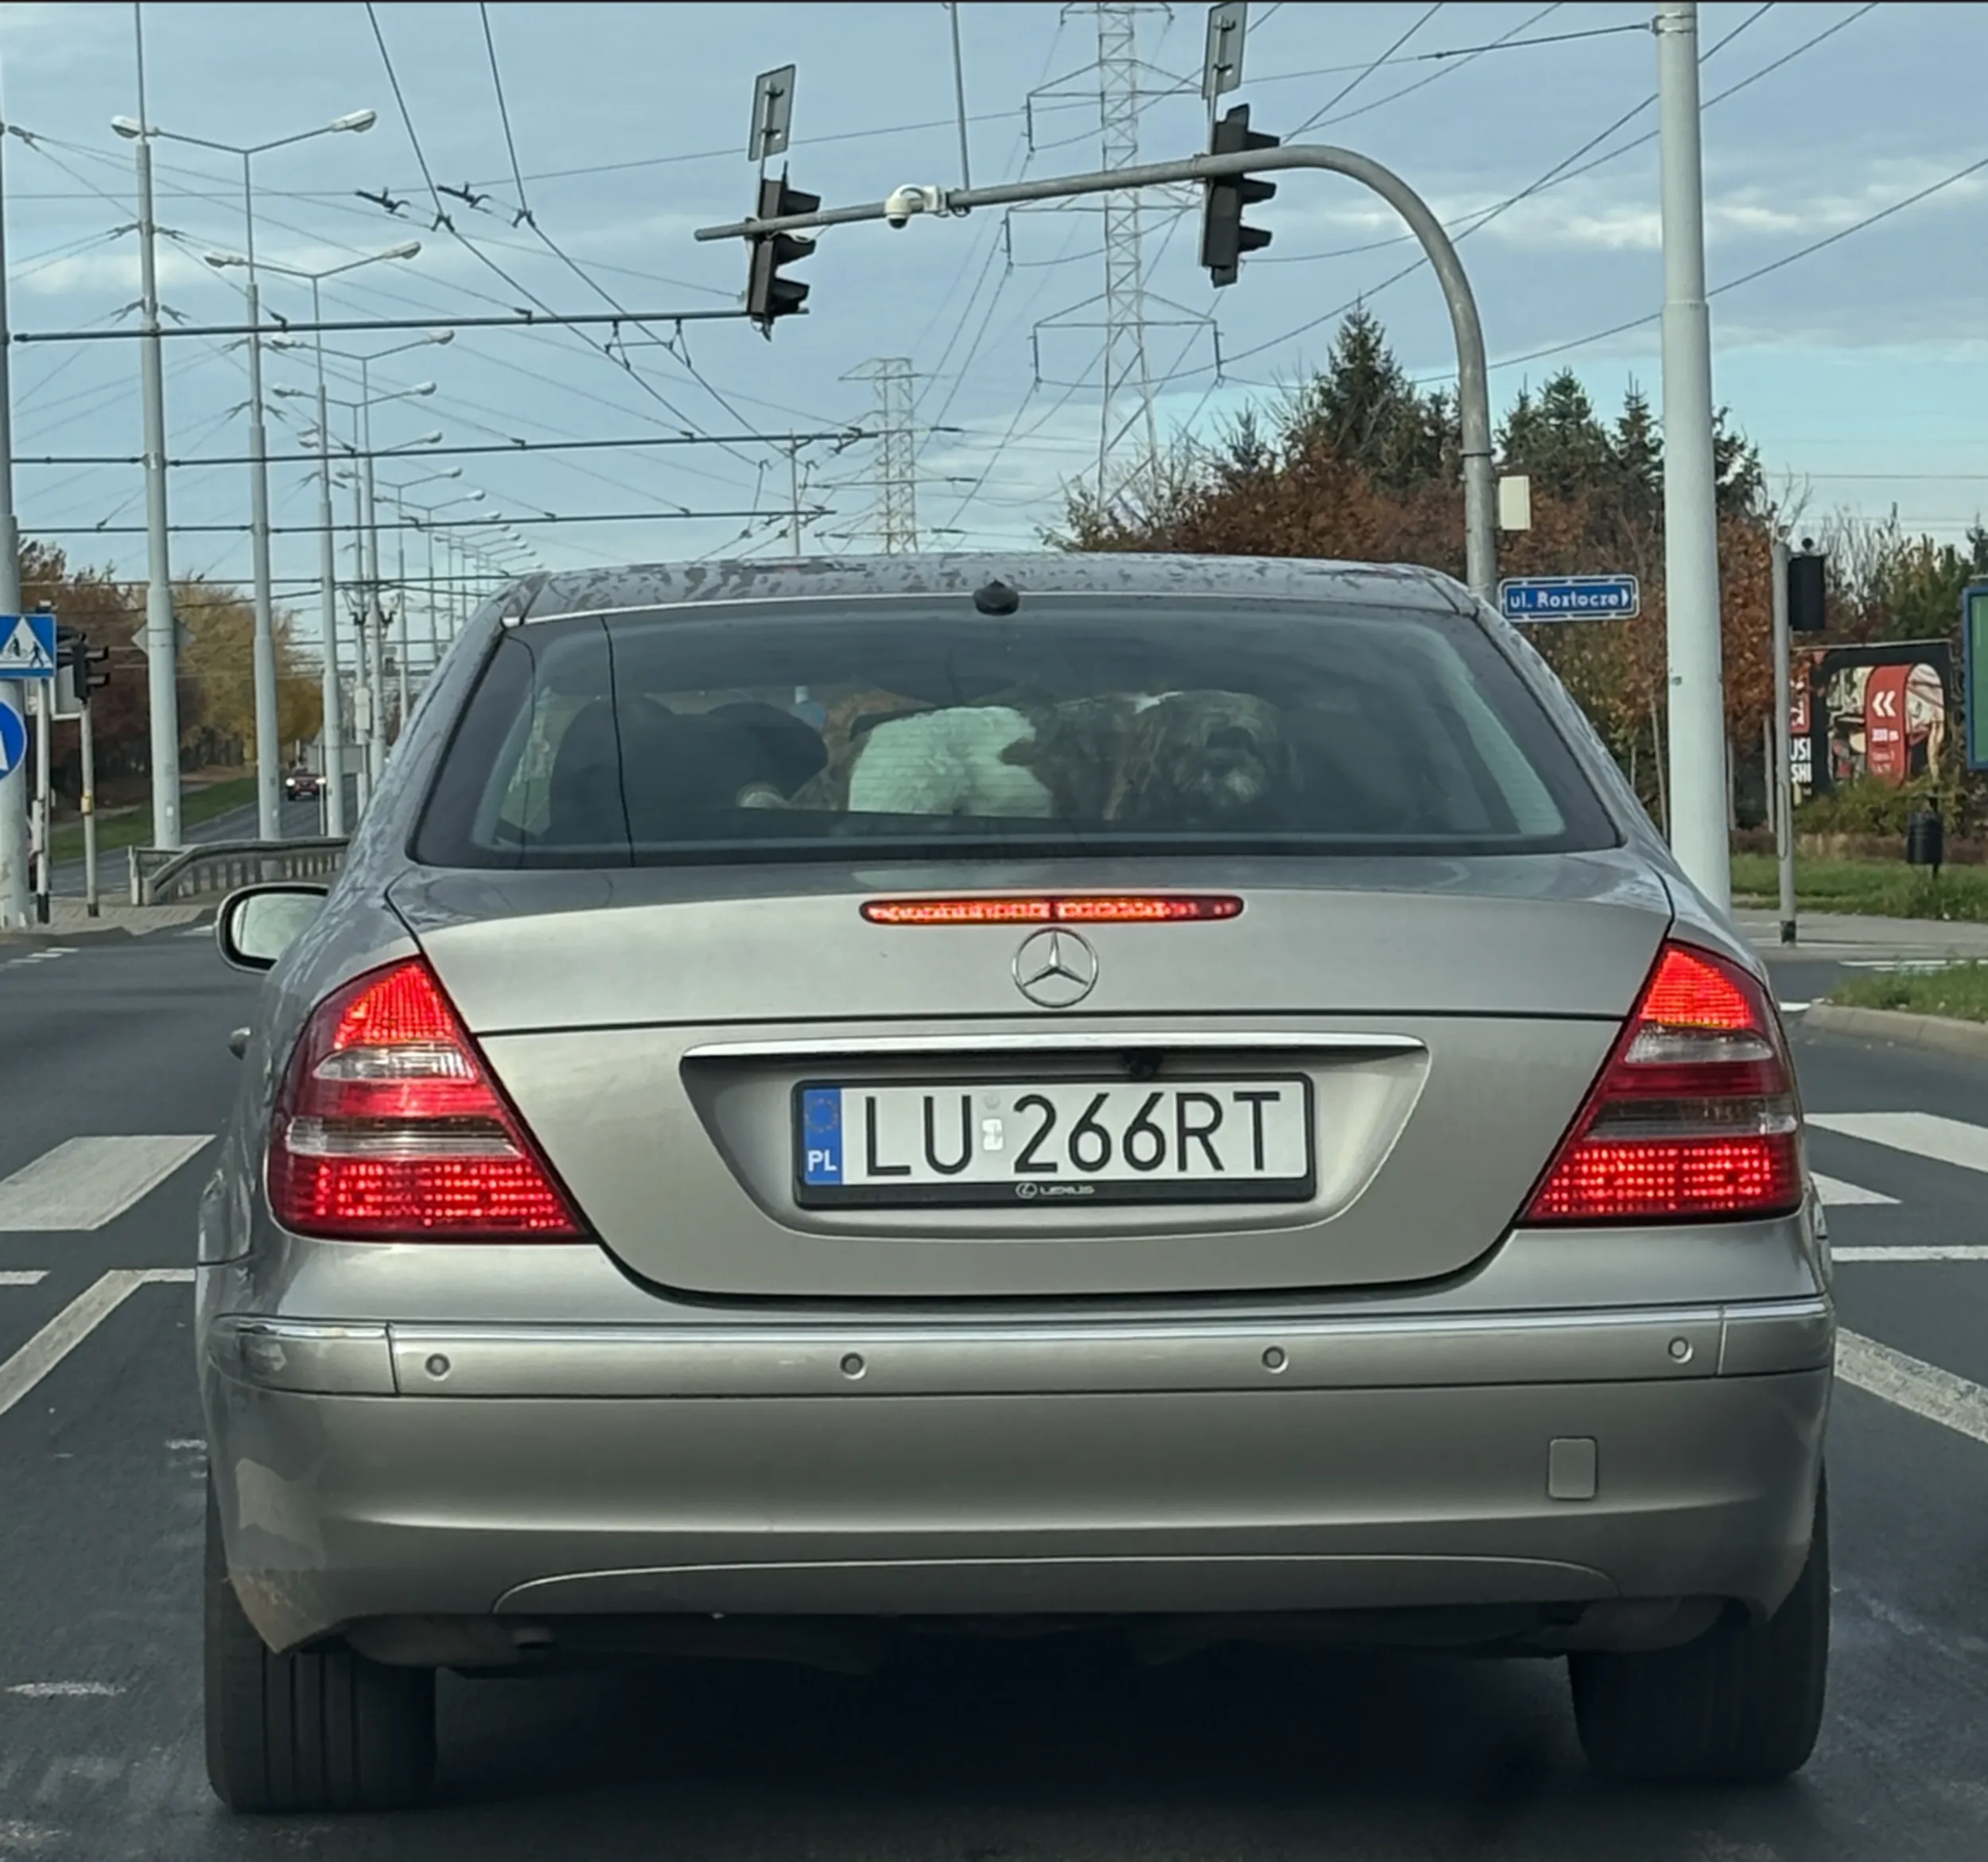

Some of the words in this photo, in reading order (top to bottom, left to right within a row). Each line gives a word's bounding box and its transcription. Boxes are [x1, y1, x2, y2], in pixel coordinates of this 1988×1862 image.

[1511, 591, 1533, 608] ul.
[866, 1094, 973, 1177] LU
[1013, 1091, 1281, 1173] 266RT
[807, 1150, 837, 1173] PL
